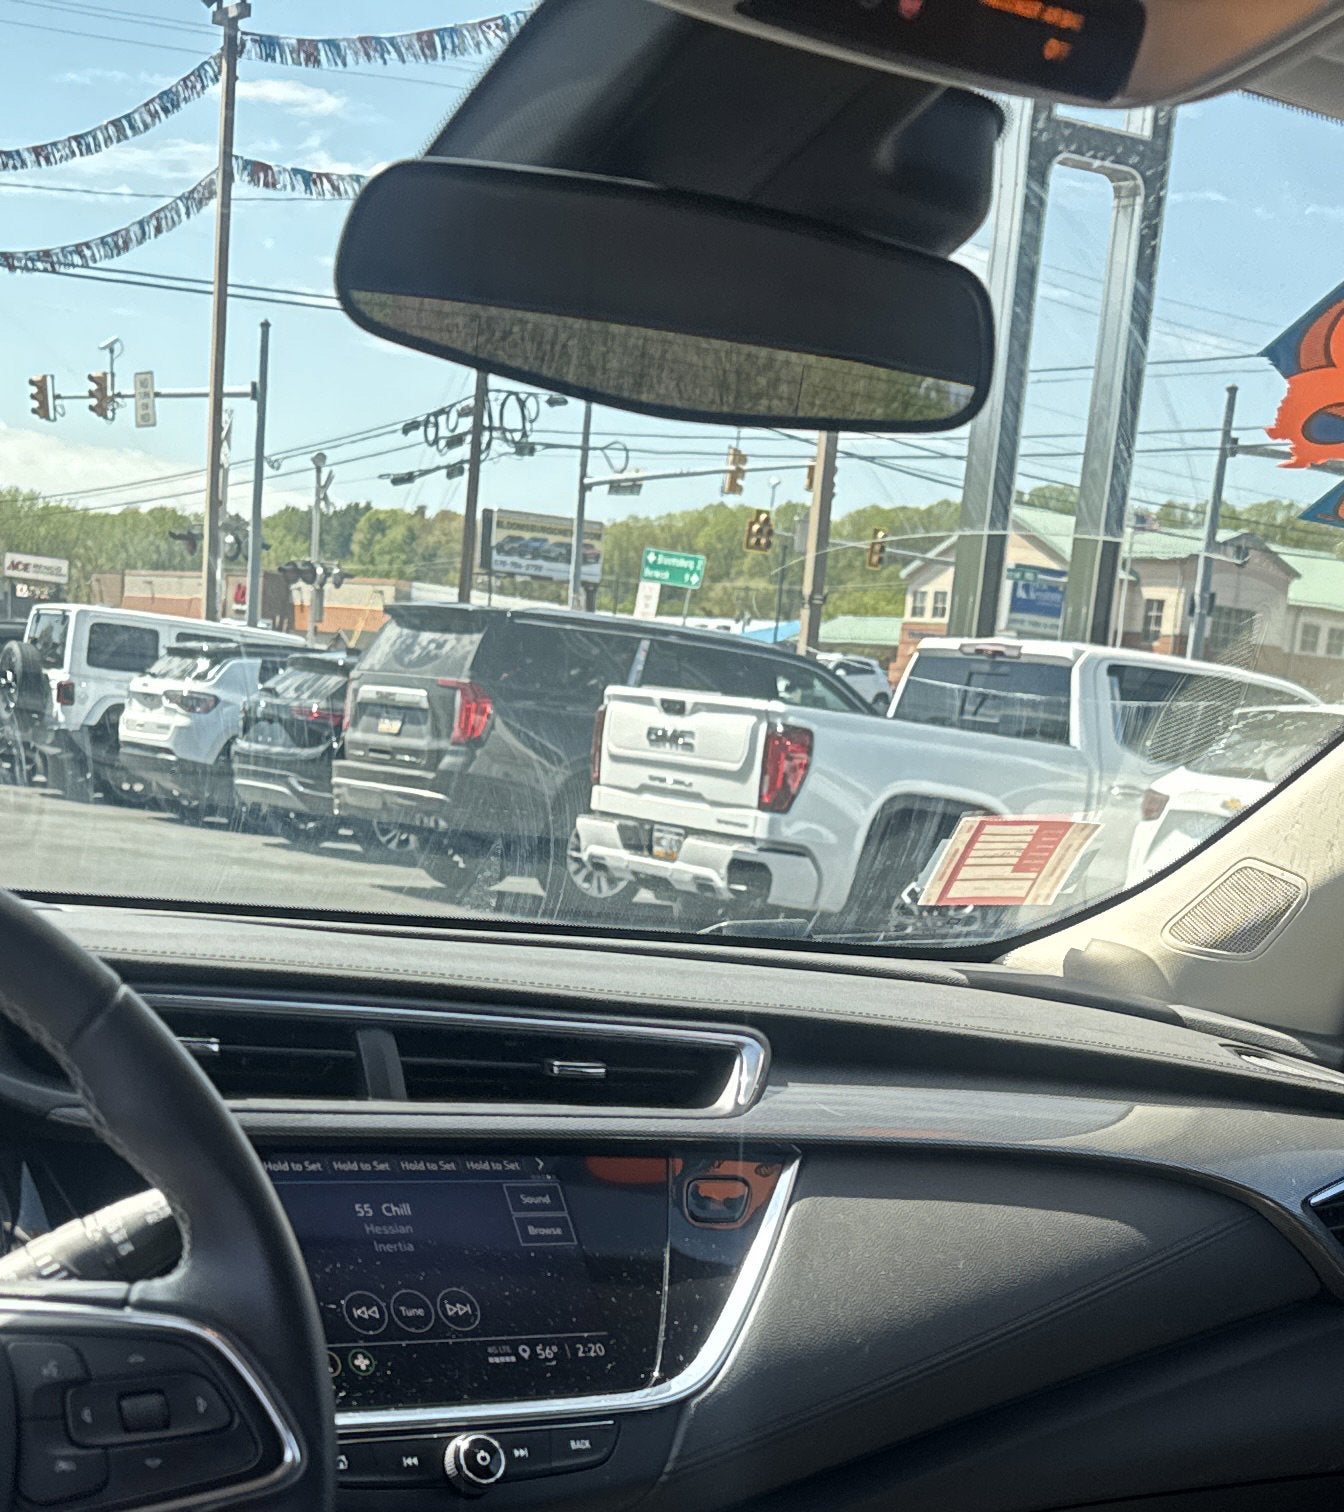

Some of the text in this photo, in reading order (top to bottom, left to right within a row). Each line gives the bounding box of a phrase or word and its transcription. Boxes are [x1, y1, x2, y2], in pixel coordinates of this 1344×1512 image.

[6, 559, 32, 574] ACE
[646, 725, 696, 753] GMC
[264, 1161, 323, 1172] Hold to Set
[332, 1160, 391, 1171] Hold to Set
[400, 1160, 456, 1171] Hold to Set
[466, 1160, 520, 1170] Hold to Set
[520, 1193, 552, 1205] Sound
[354, 1203, 412, 1217] 55 Chill
[364, 1223, 414, 1235] Hessian
[527, 1224, 563, 1236] Browse
[373, 1240, 415, 1252] Inertia
[399, 1305, 425, 1318] Tune
[536, 1343, 558, 1359] 56°
[575, 1343, 606, 1358] 2:20
[569, 1439, 592, 1450] BACK
